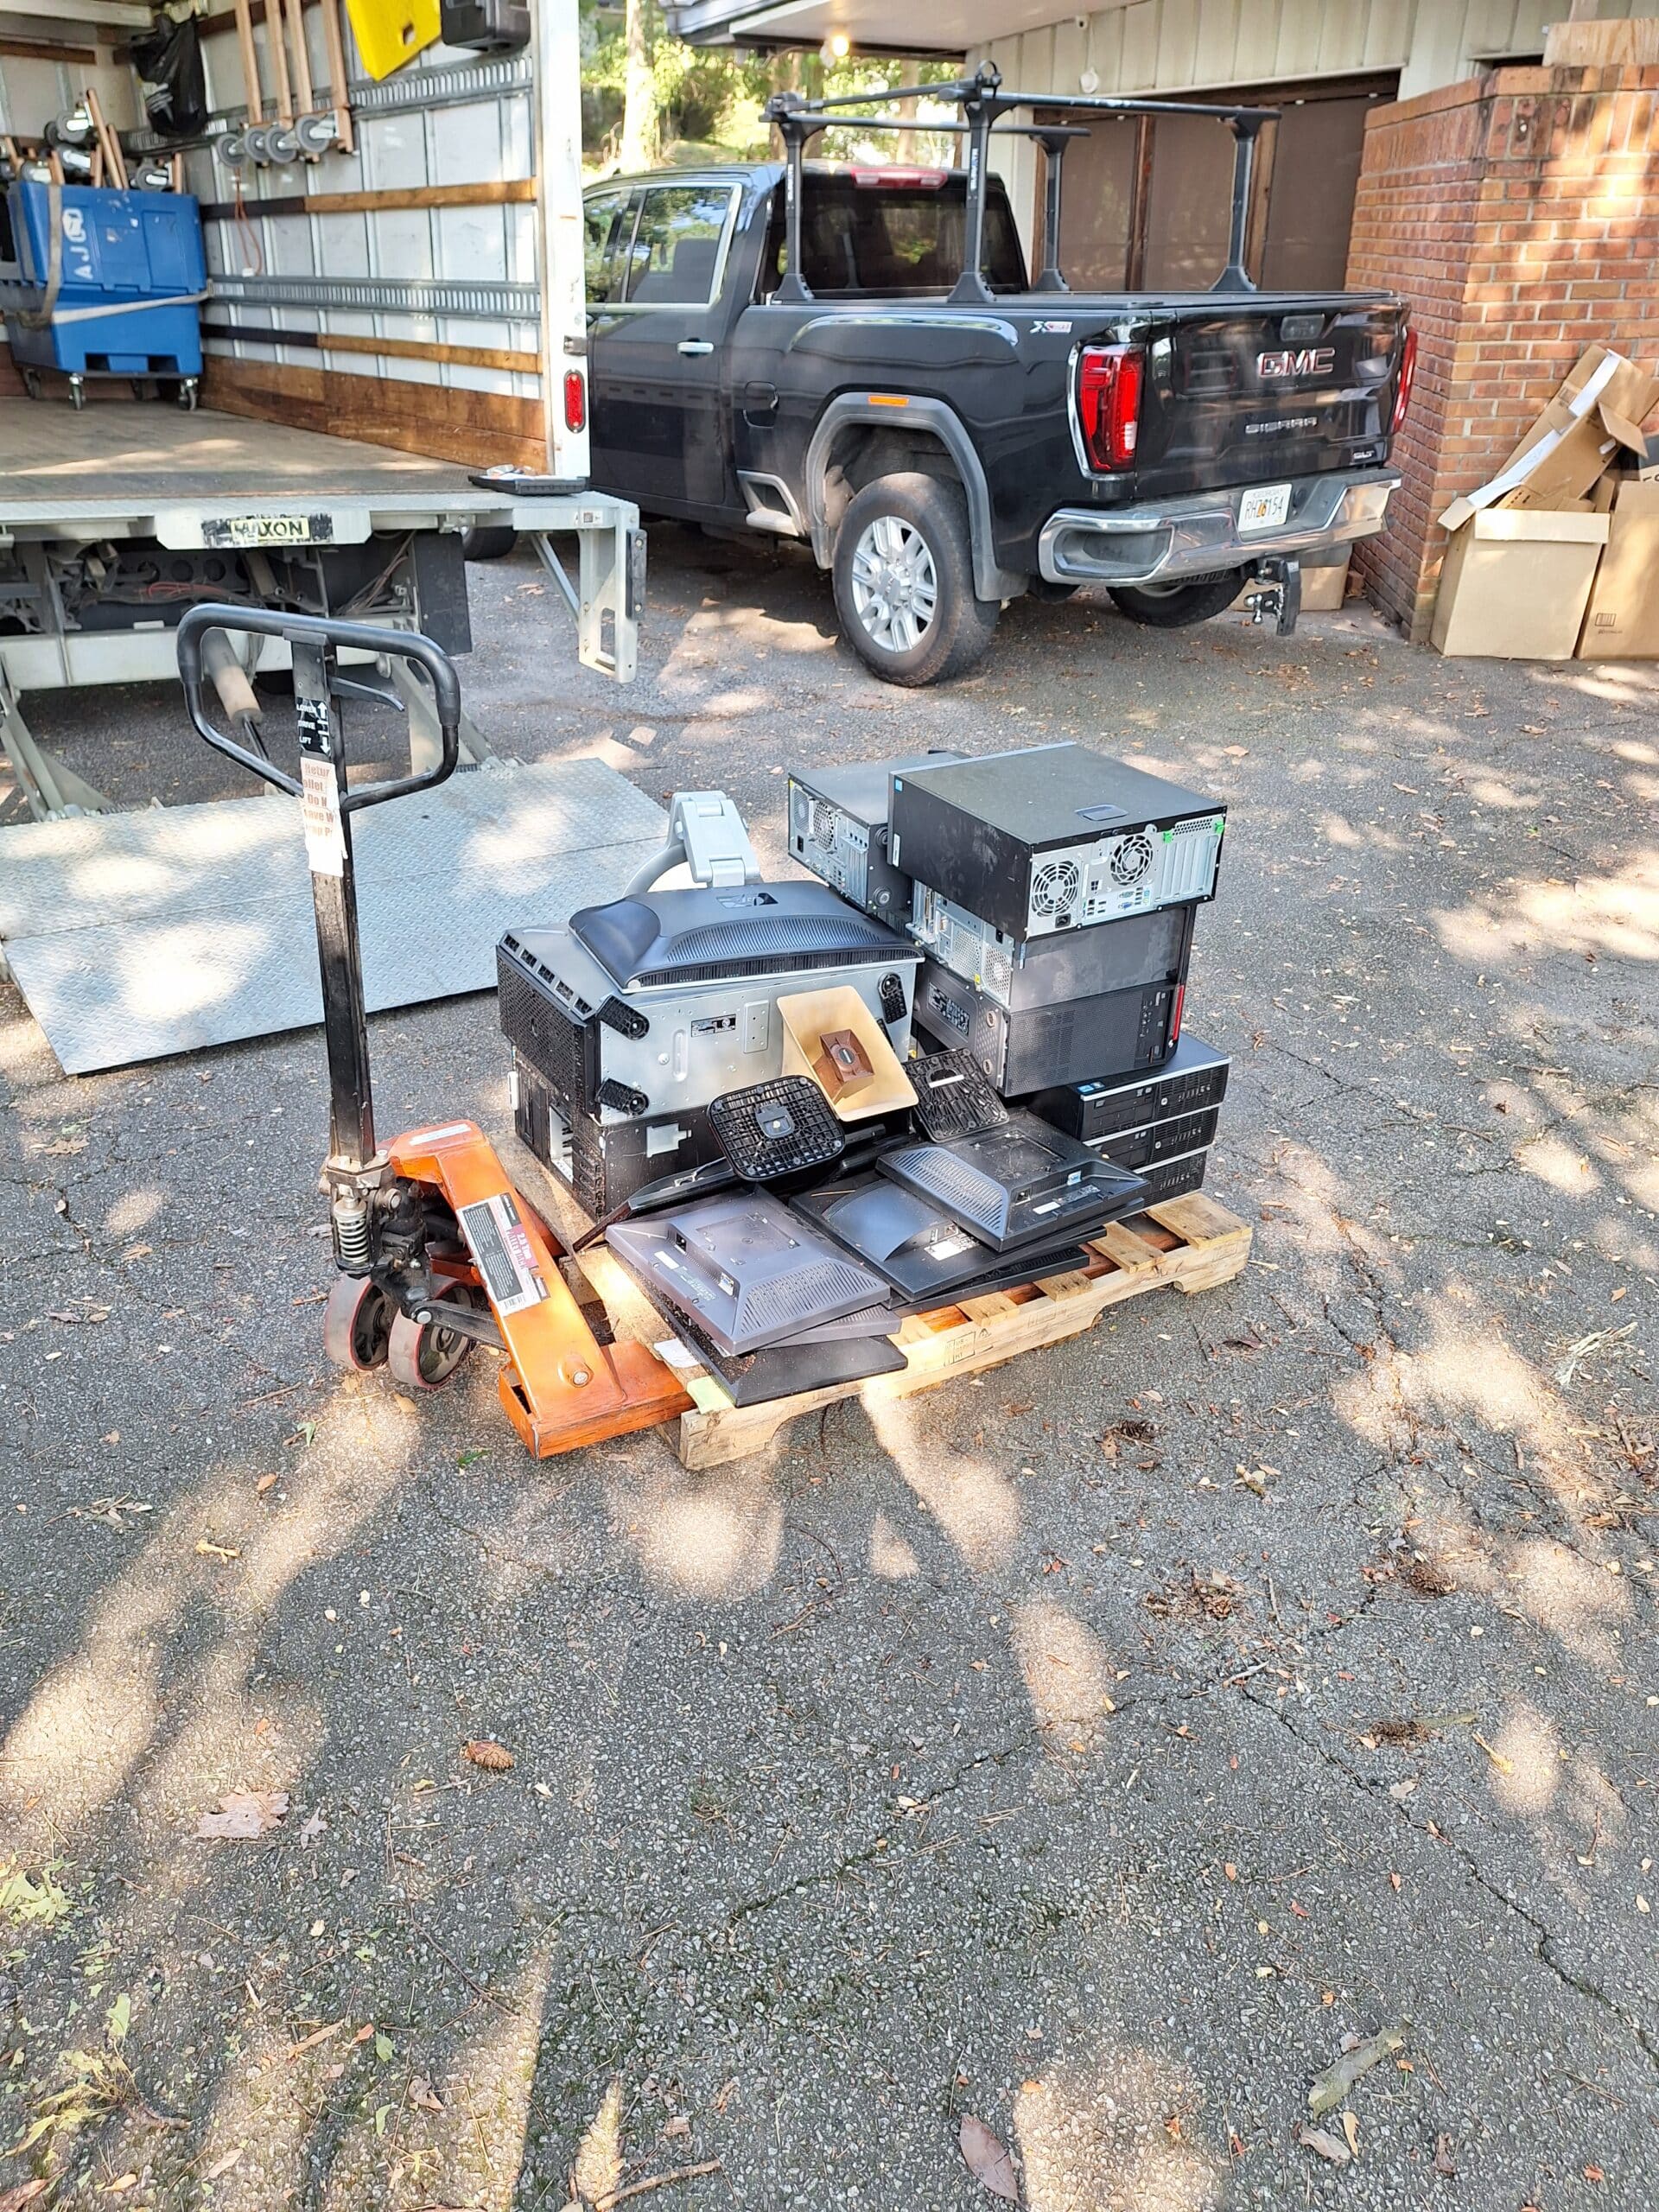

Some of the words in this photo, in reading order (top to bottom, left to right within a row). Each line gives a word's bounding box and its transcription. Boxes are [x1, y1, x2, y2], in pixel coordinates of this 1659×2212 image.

[1257, 347, 1335, 378] GMC
[1245, 416, 1318, 434] SIERRA
[298, 720, 315, 730] DRIVE
[299, 735, 311, 745] LIFT
